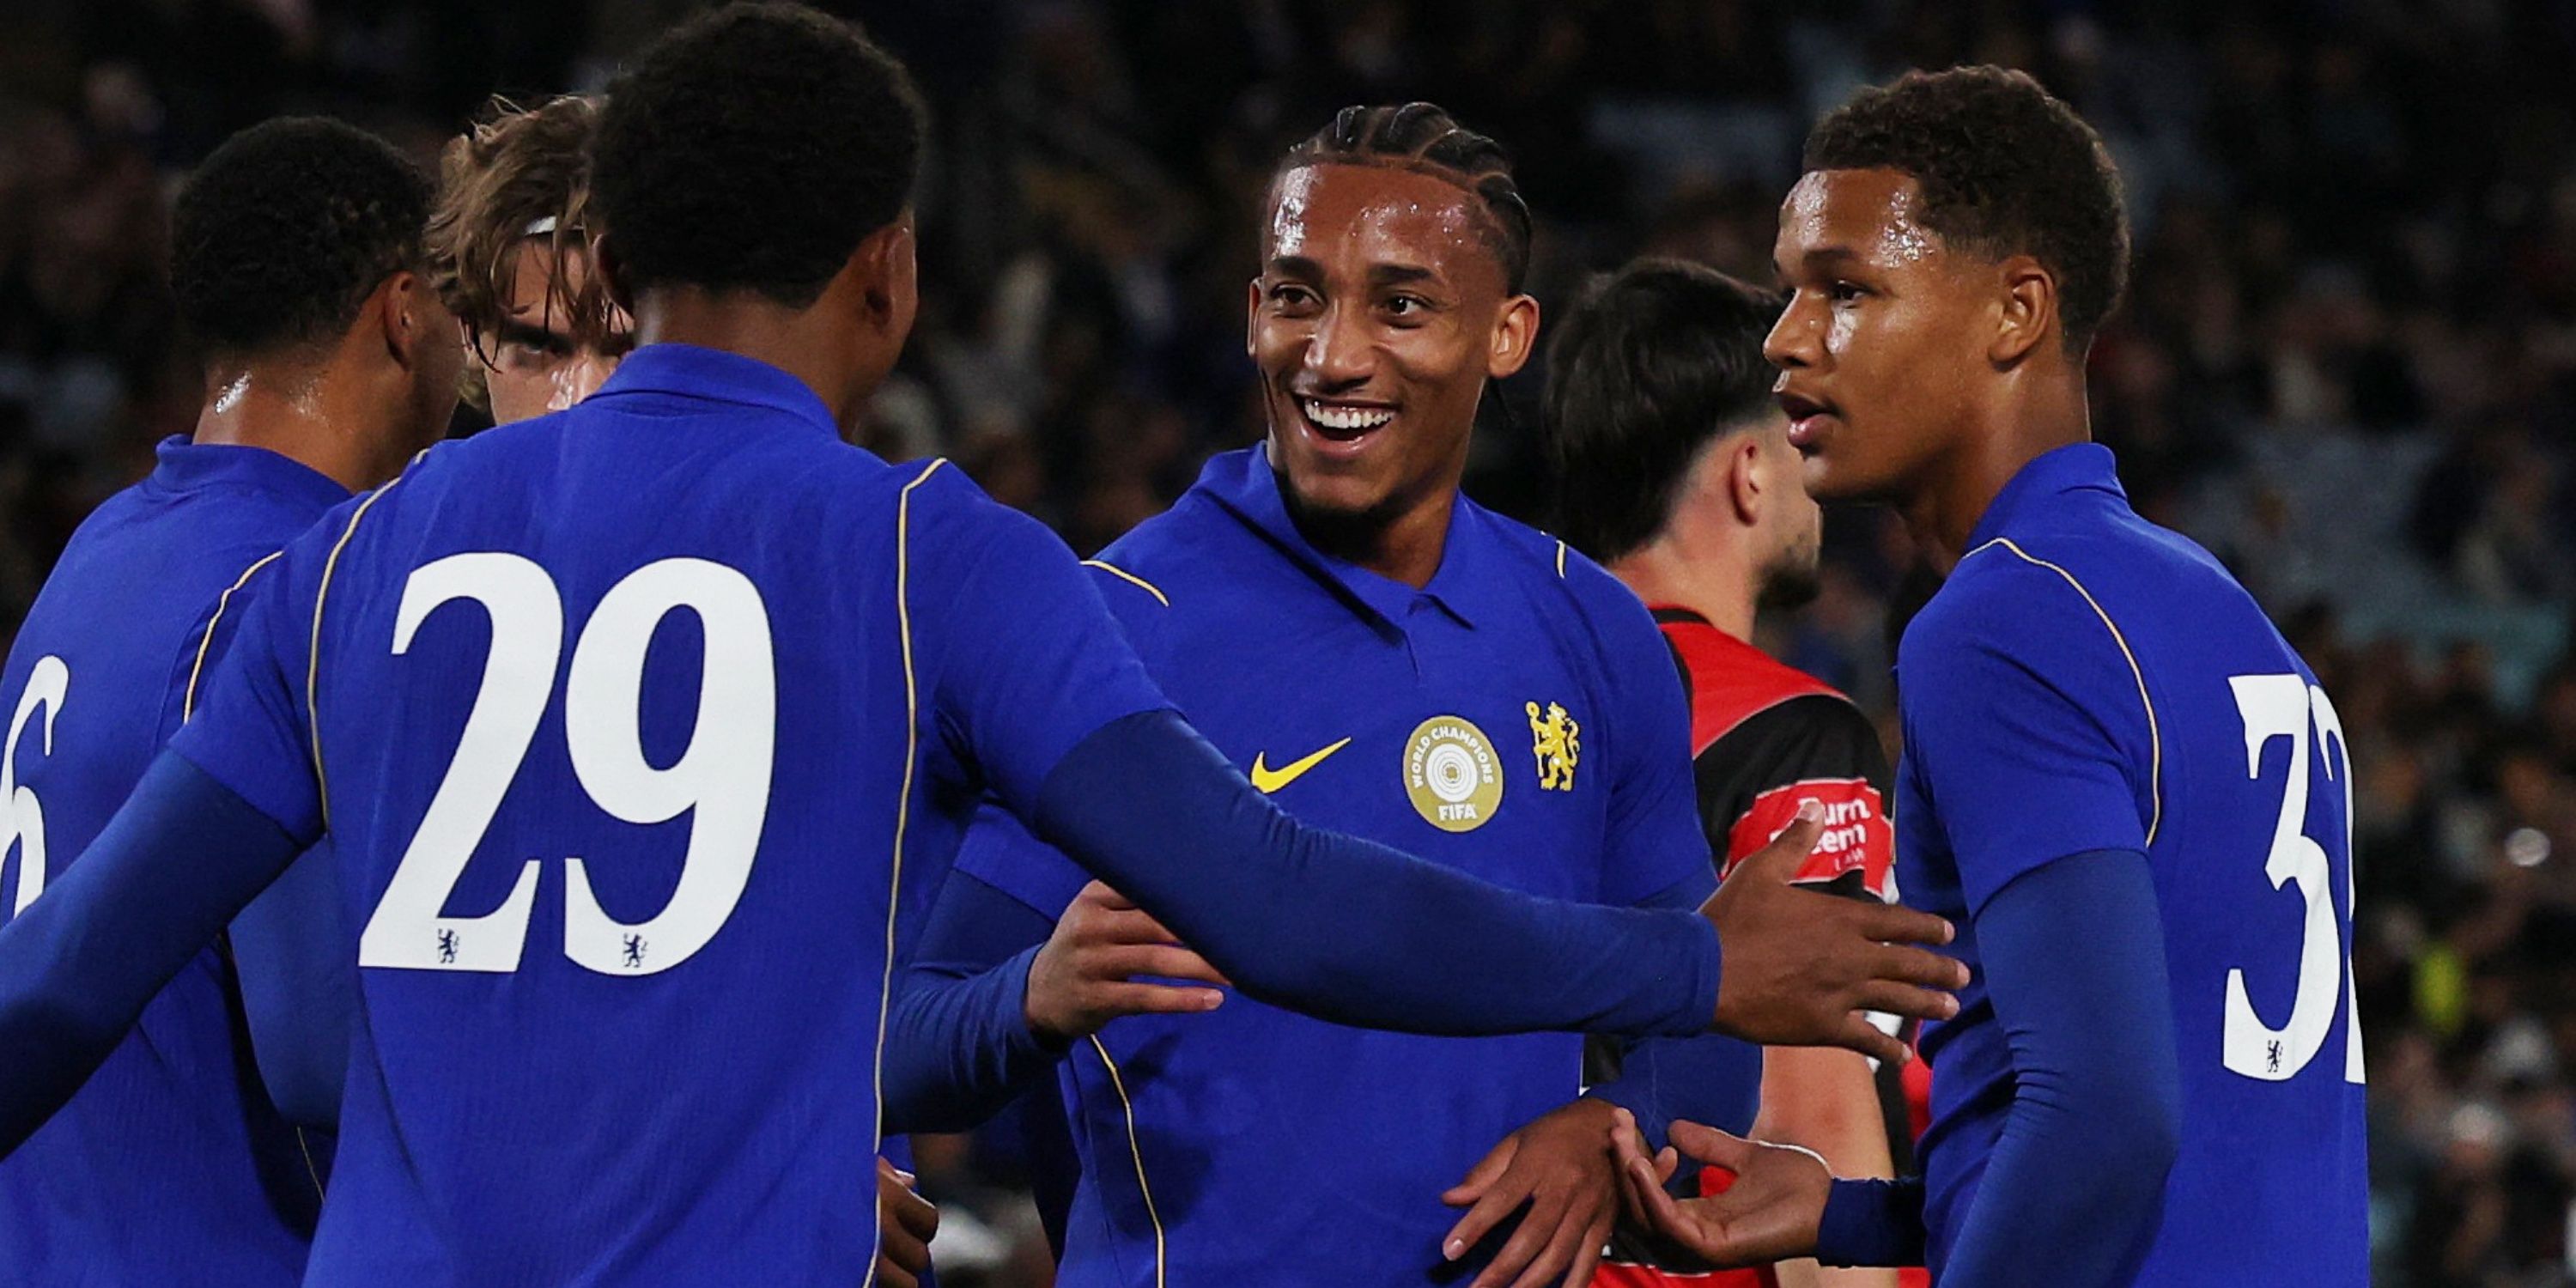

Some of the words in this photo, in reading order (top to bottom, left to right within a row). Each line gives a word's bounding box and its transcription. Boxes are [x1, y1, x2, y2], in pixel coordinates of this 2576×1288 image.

[359, 552, 776, 976] 29
[1412, 736, 1431, 788] WORLD
[1431, 726, 1494, 784] CHAMPIONS
[1438, 804, 1477, 821] FIFA
